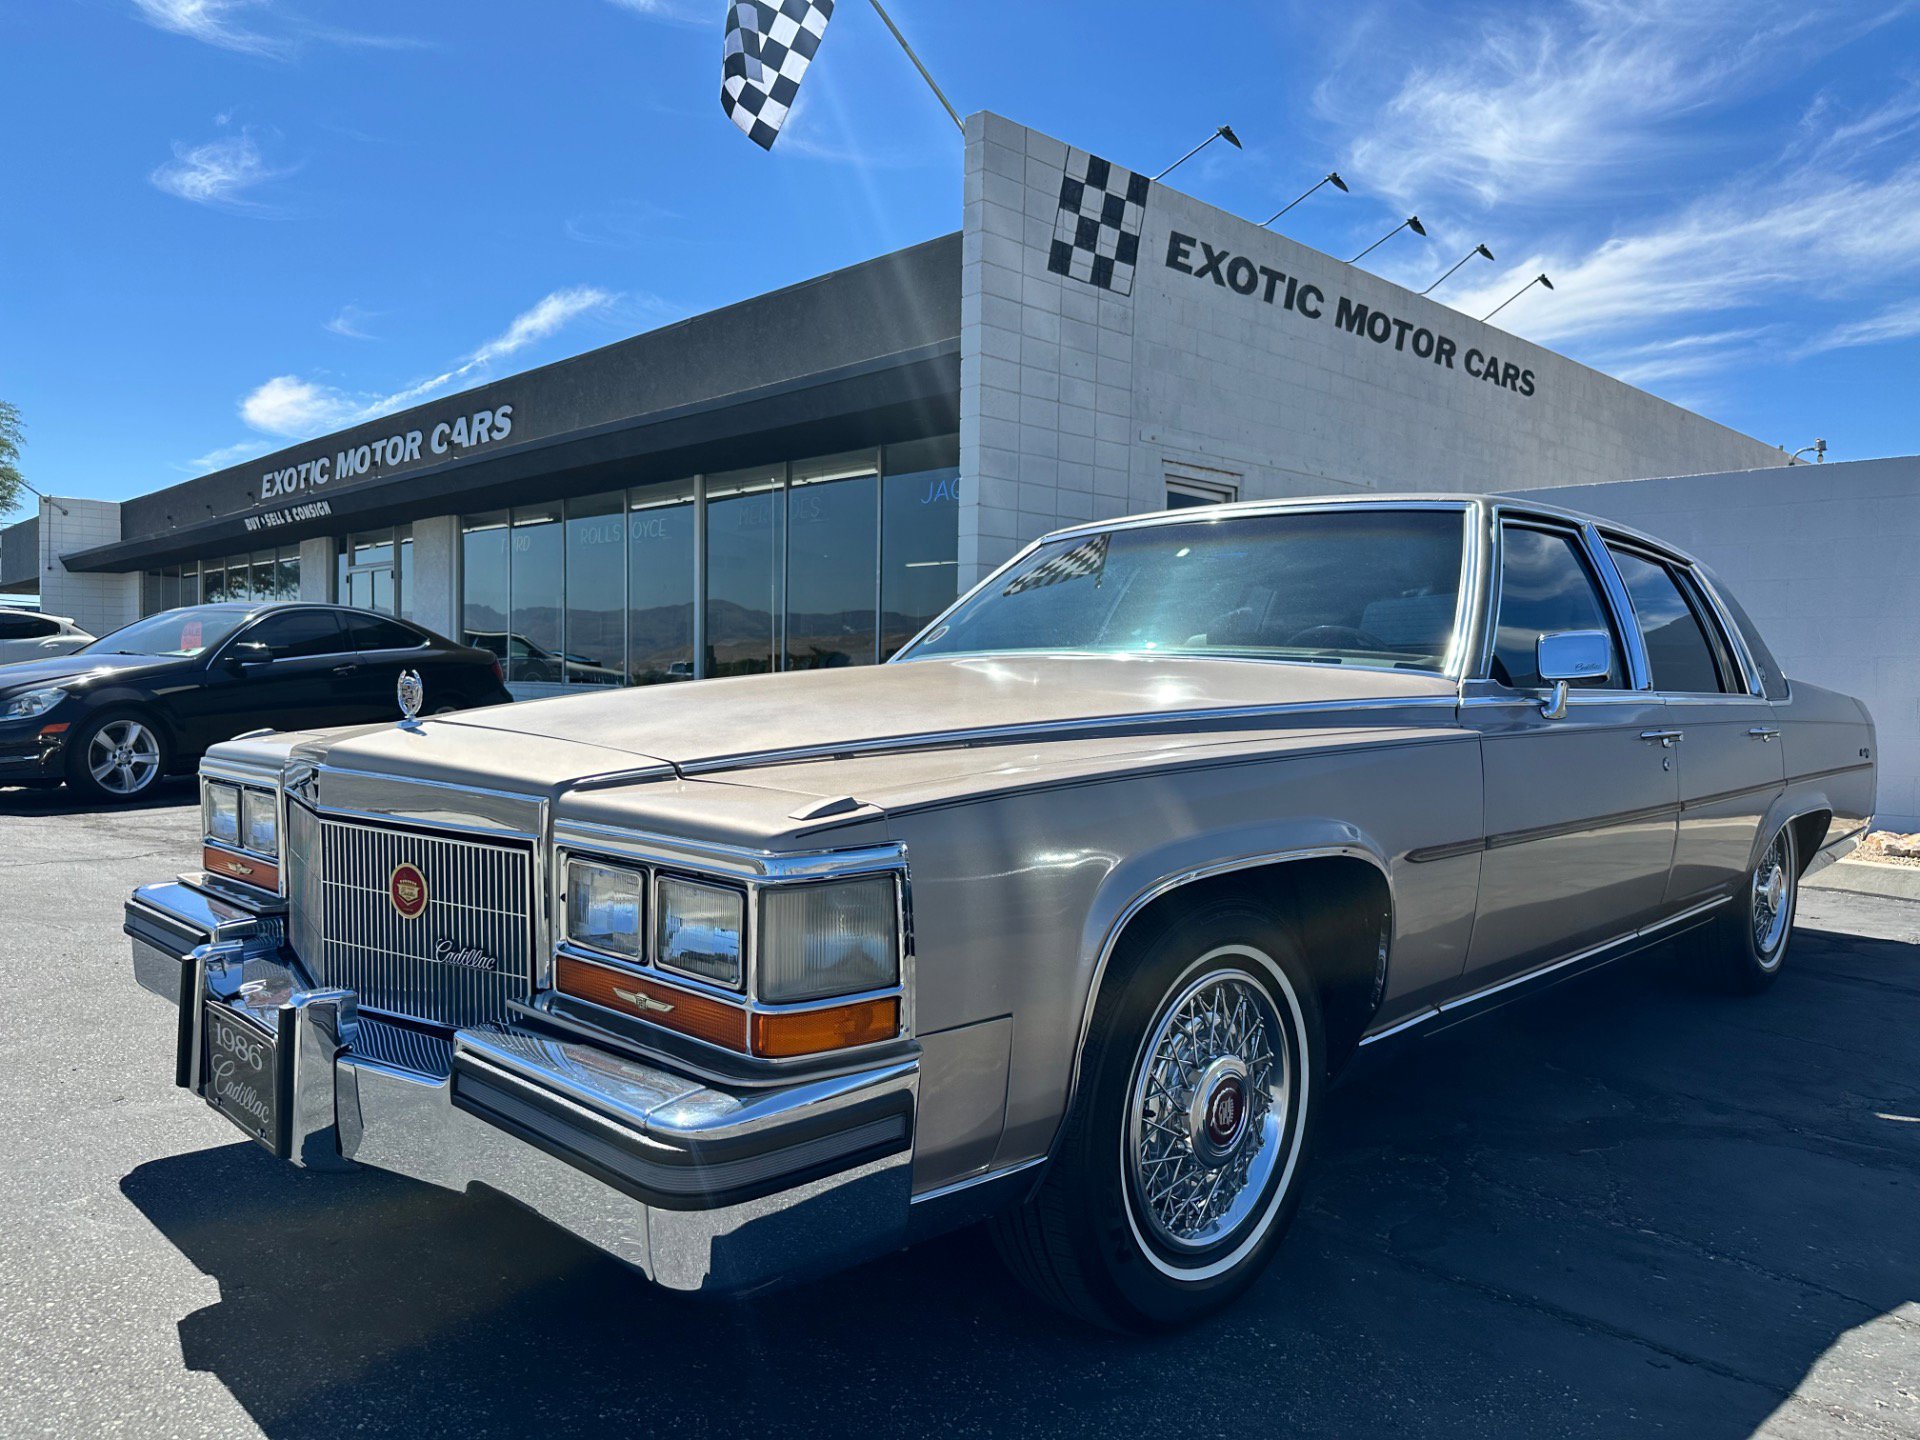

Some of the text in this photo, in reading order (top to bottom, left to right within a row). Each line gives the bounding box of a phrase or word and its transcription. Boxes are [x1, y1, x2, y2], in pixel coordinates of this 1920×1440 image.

[1165, 230, 1536, 397] EXOTIC MOTOR CARS
[260, 404, 513, 499] EXOTIC MOTOR CARS
[244, 500, 332, 531] BUY SELL & CONSIGN
[581, 518, 667, 545] ROLLS OYCE
[435, 938, 496, 970] Cadillac
[215, 1022, 263, 1071] 1986
[211, 1053, 270, 1124] Cadillac
